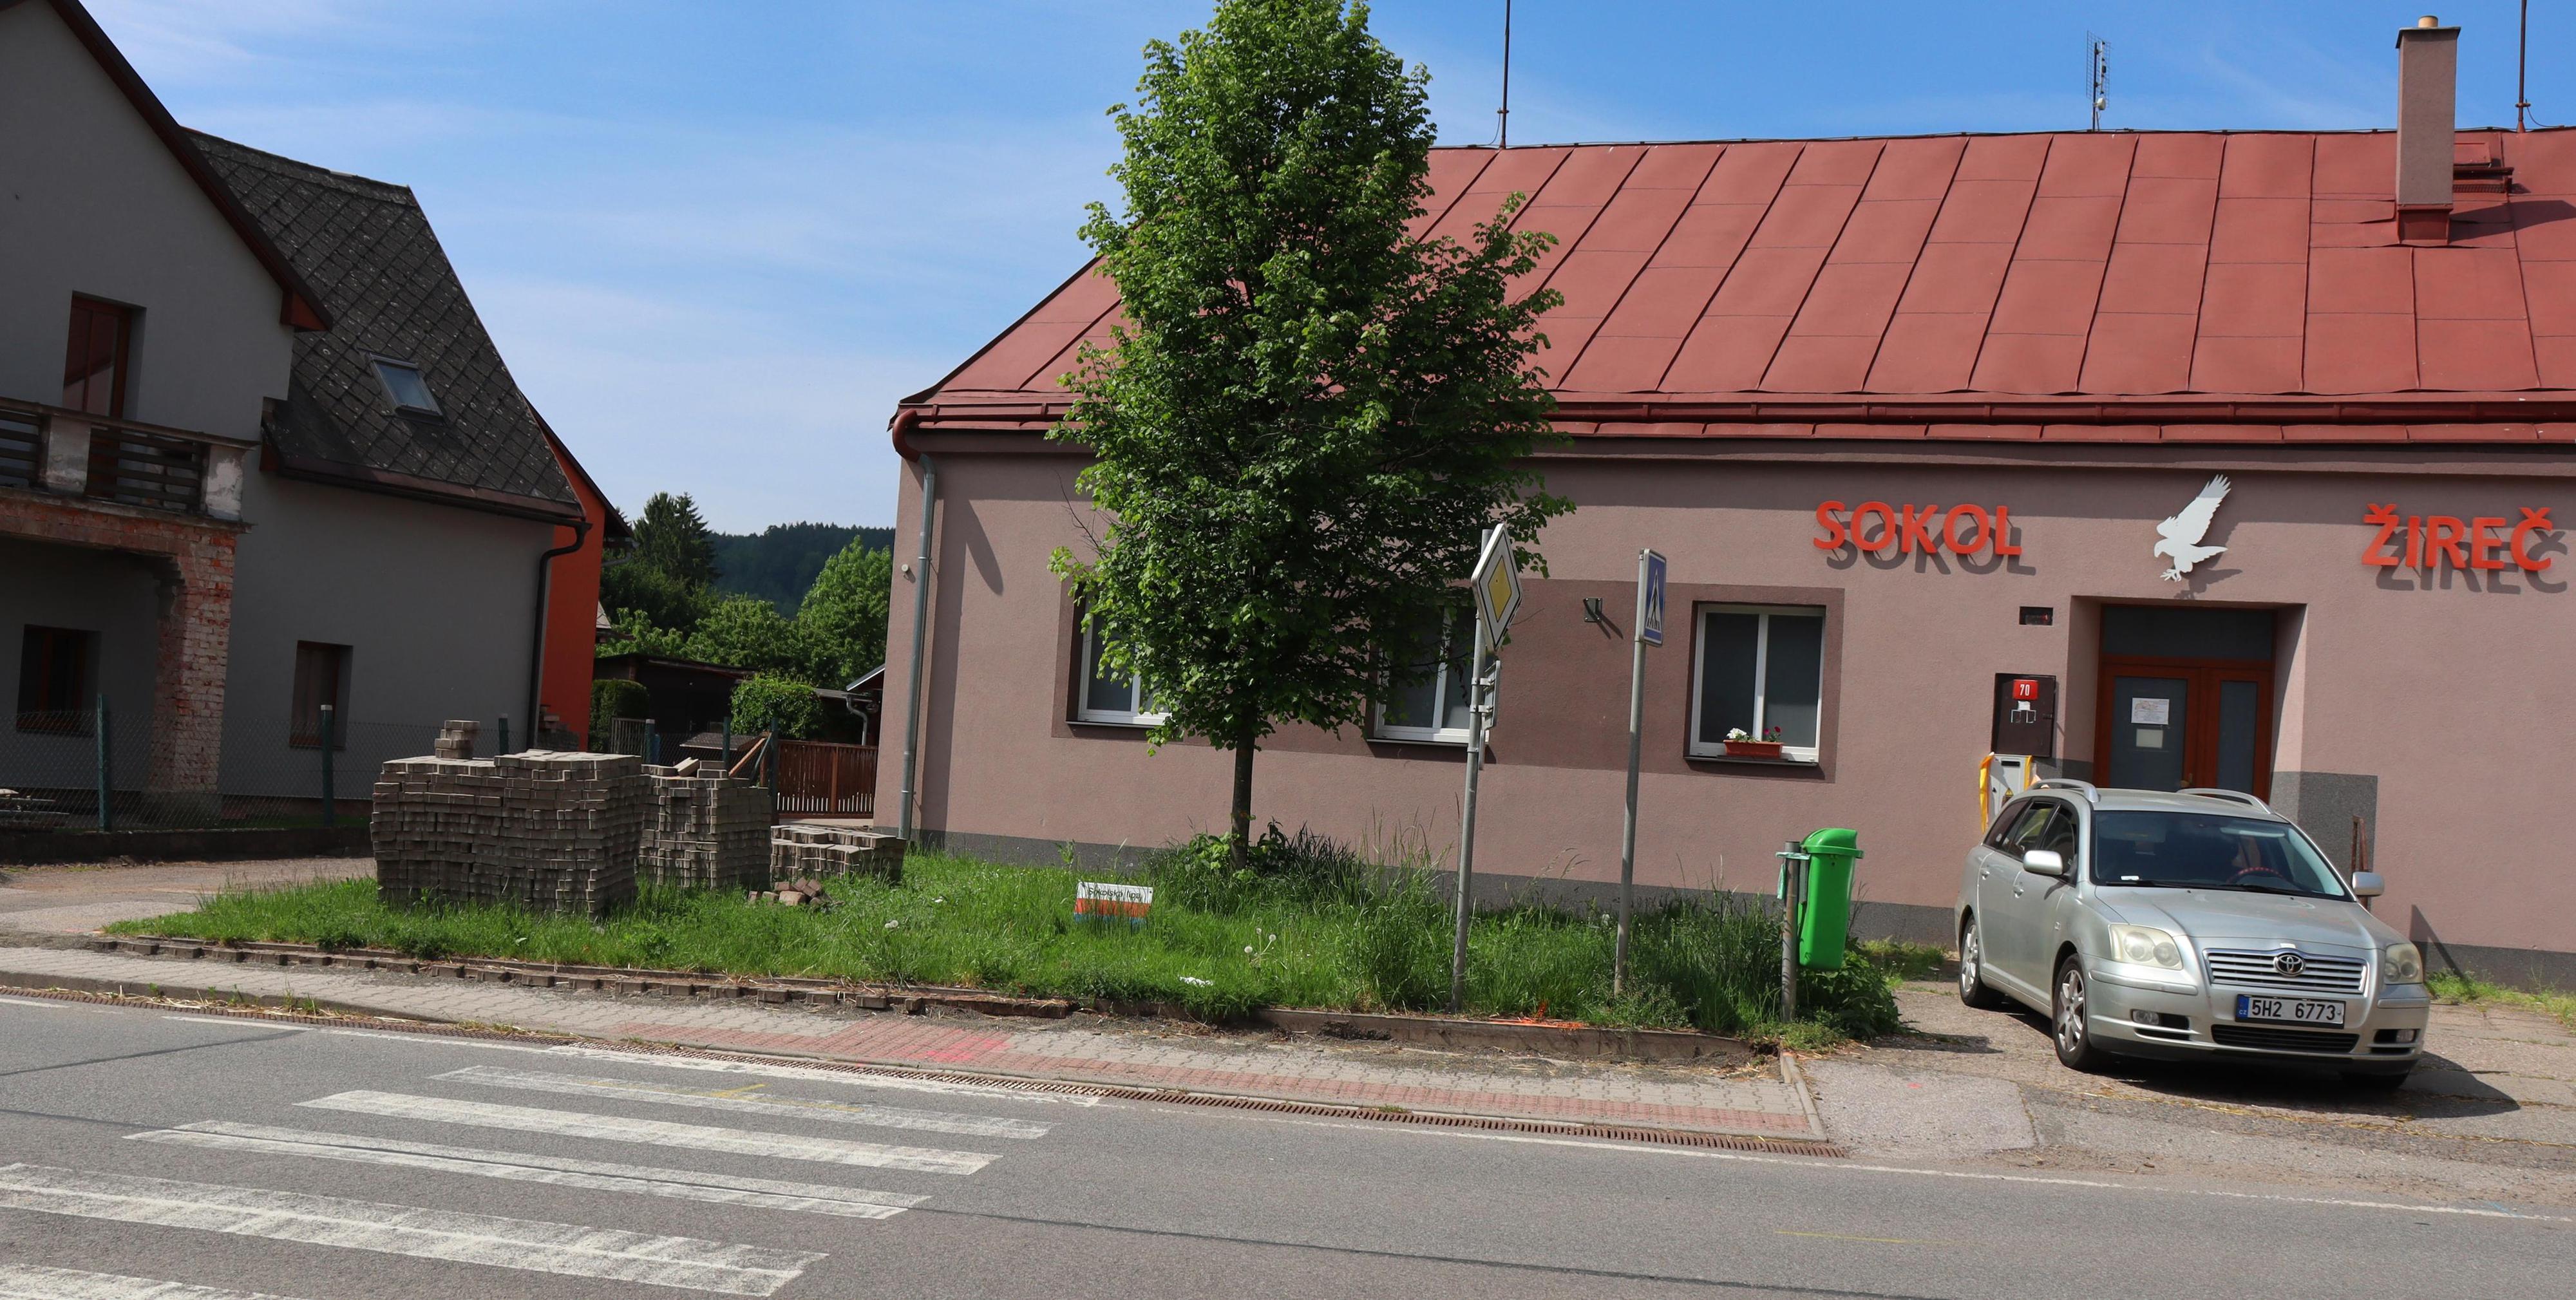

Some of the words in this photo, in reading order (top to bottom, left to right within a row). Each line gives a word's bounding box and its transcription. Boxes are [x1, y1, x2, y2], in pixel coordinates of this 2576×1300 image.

[1814, 500, 2022, 555] SOKOL
[2362, 504, 2553, 571] ŽIREČ
[2020, 684, 2031, 696] 70
[2251, 999, 2282, 1017] 5H2
[2295, 1003, 2336, 1021] 6773
